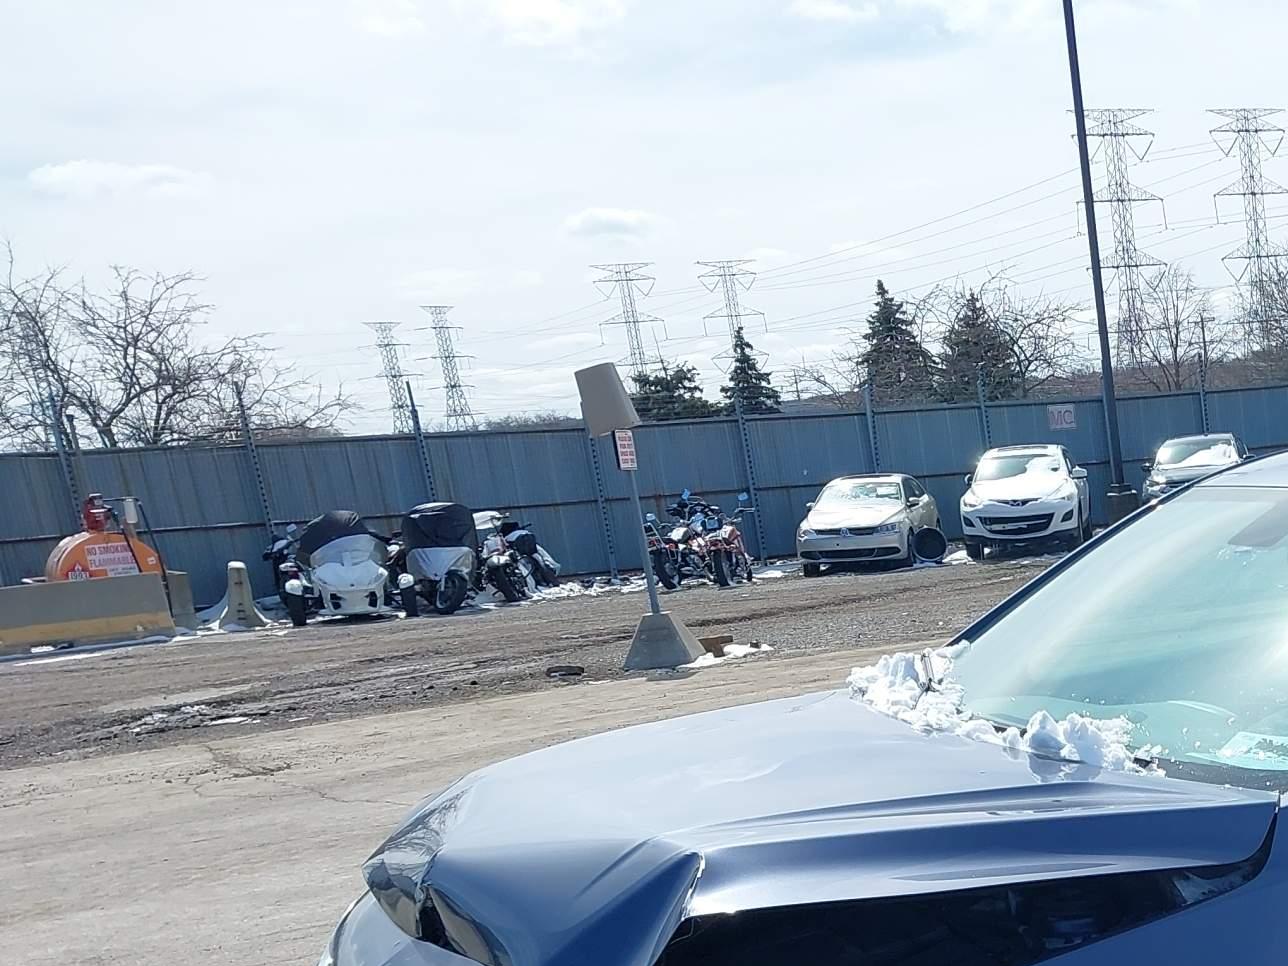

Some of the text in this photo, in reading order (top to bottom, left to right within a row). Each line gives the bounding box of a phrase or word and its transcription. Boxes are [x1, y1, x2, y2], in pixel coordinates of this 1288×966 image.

[1049, 409, 1075, 427] MC
[86, 542, 129, 557] NO SMOKIN
